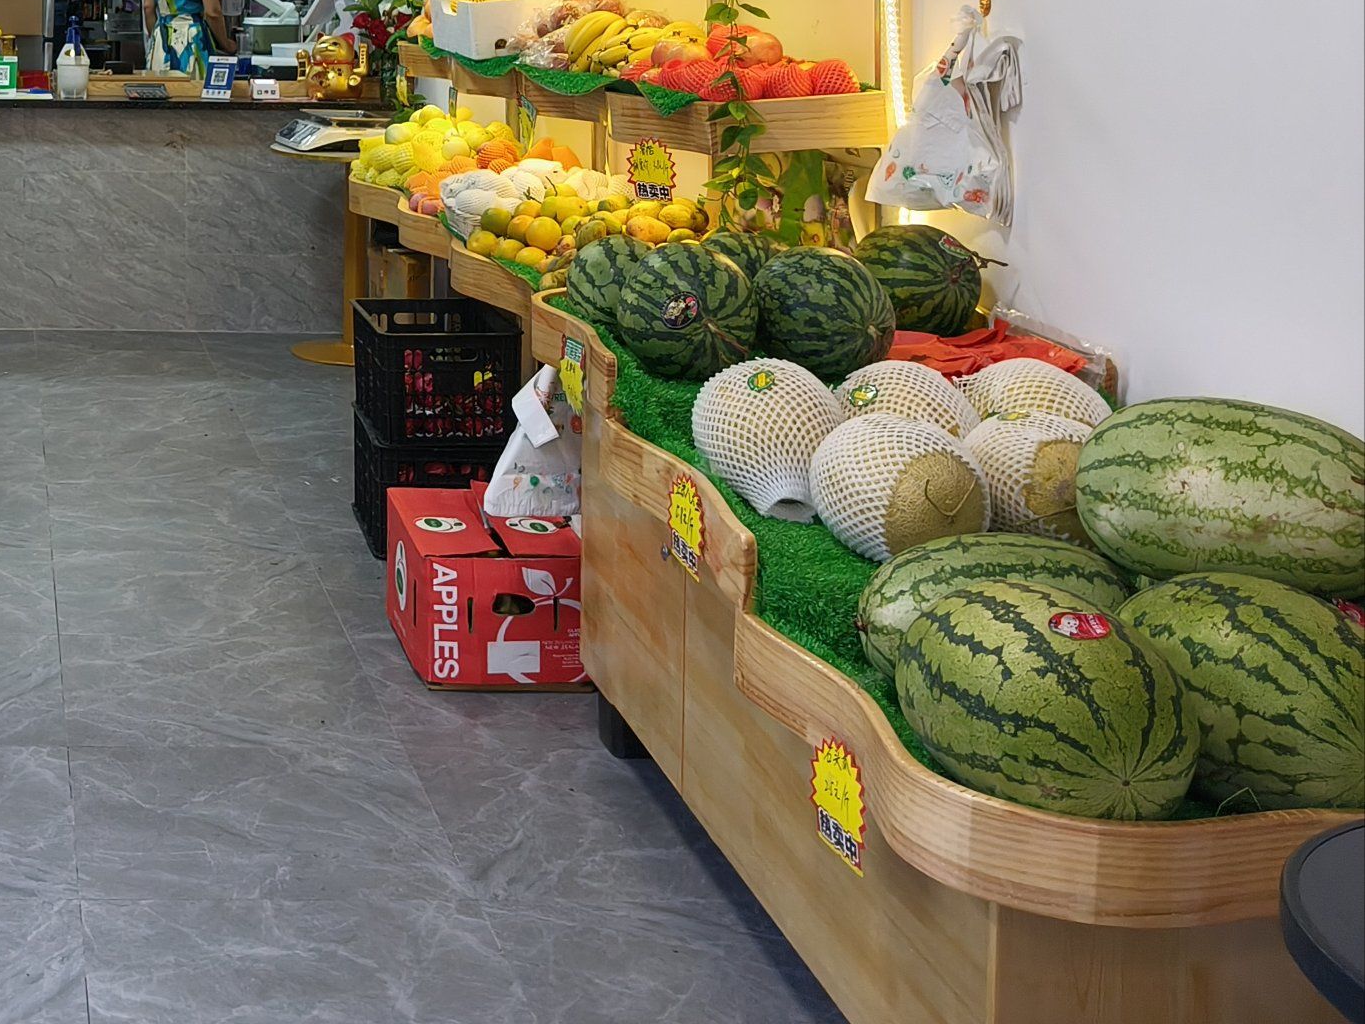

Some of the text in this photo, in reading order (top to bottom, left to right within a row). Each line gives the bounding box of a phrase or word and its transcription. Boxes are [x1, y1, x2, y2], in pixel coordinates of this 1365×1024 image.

[637, 182, 670, 200] 热卖中
[433, 563, 459, 679] APPLES
[820, 809, 859, 864] 热卖中
